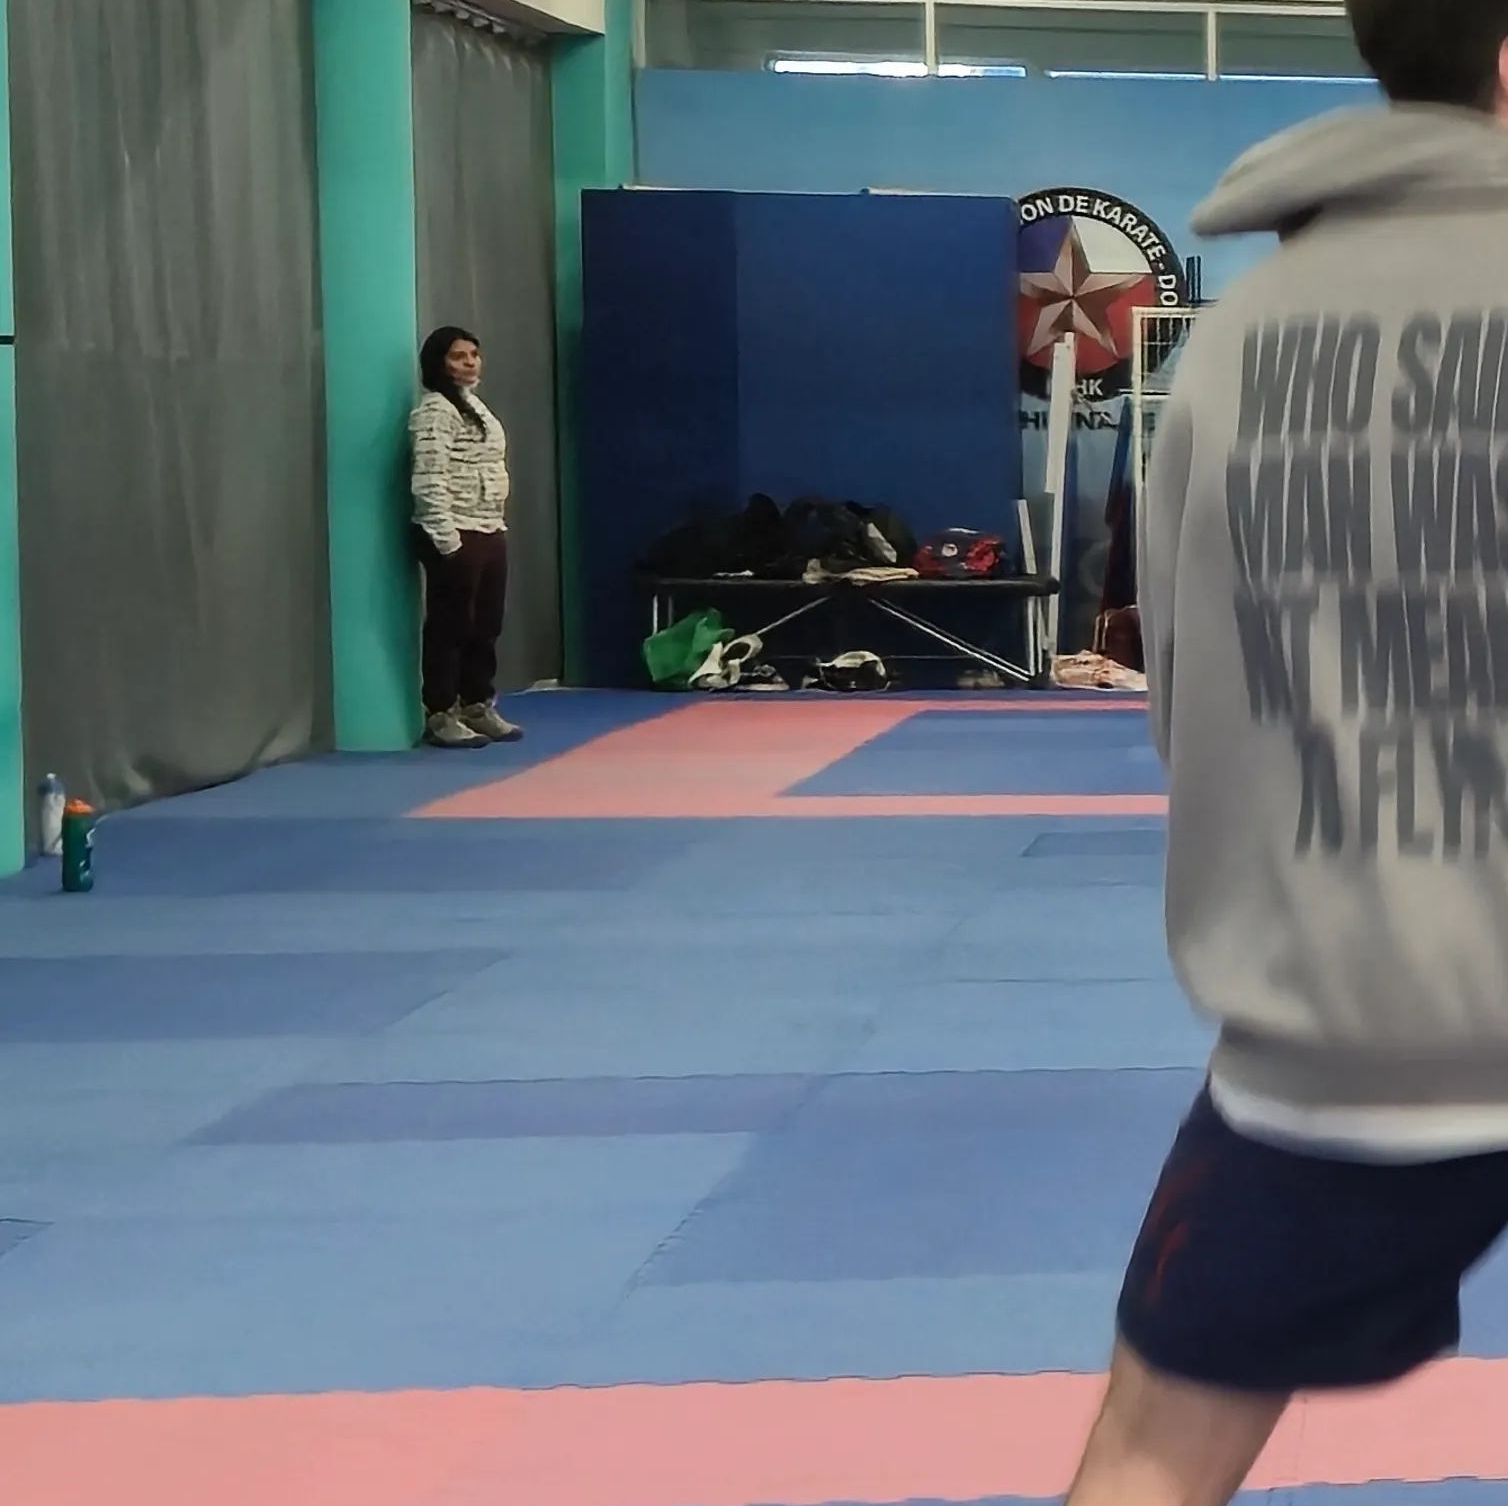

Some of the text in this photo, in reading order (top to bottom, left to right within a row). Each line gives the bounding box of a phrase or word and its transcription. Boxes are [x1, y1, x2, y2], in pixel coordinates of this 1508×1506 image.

[1058, 194, 1089, 213] DE
[1236, 312, 1381, 435] WHO
[1226, 448, 1373, 575] MAN
